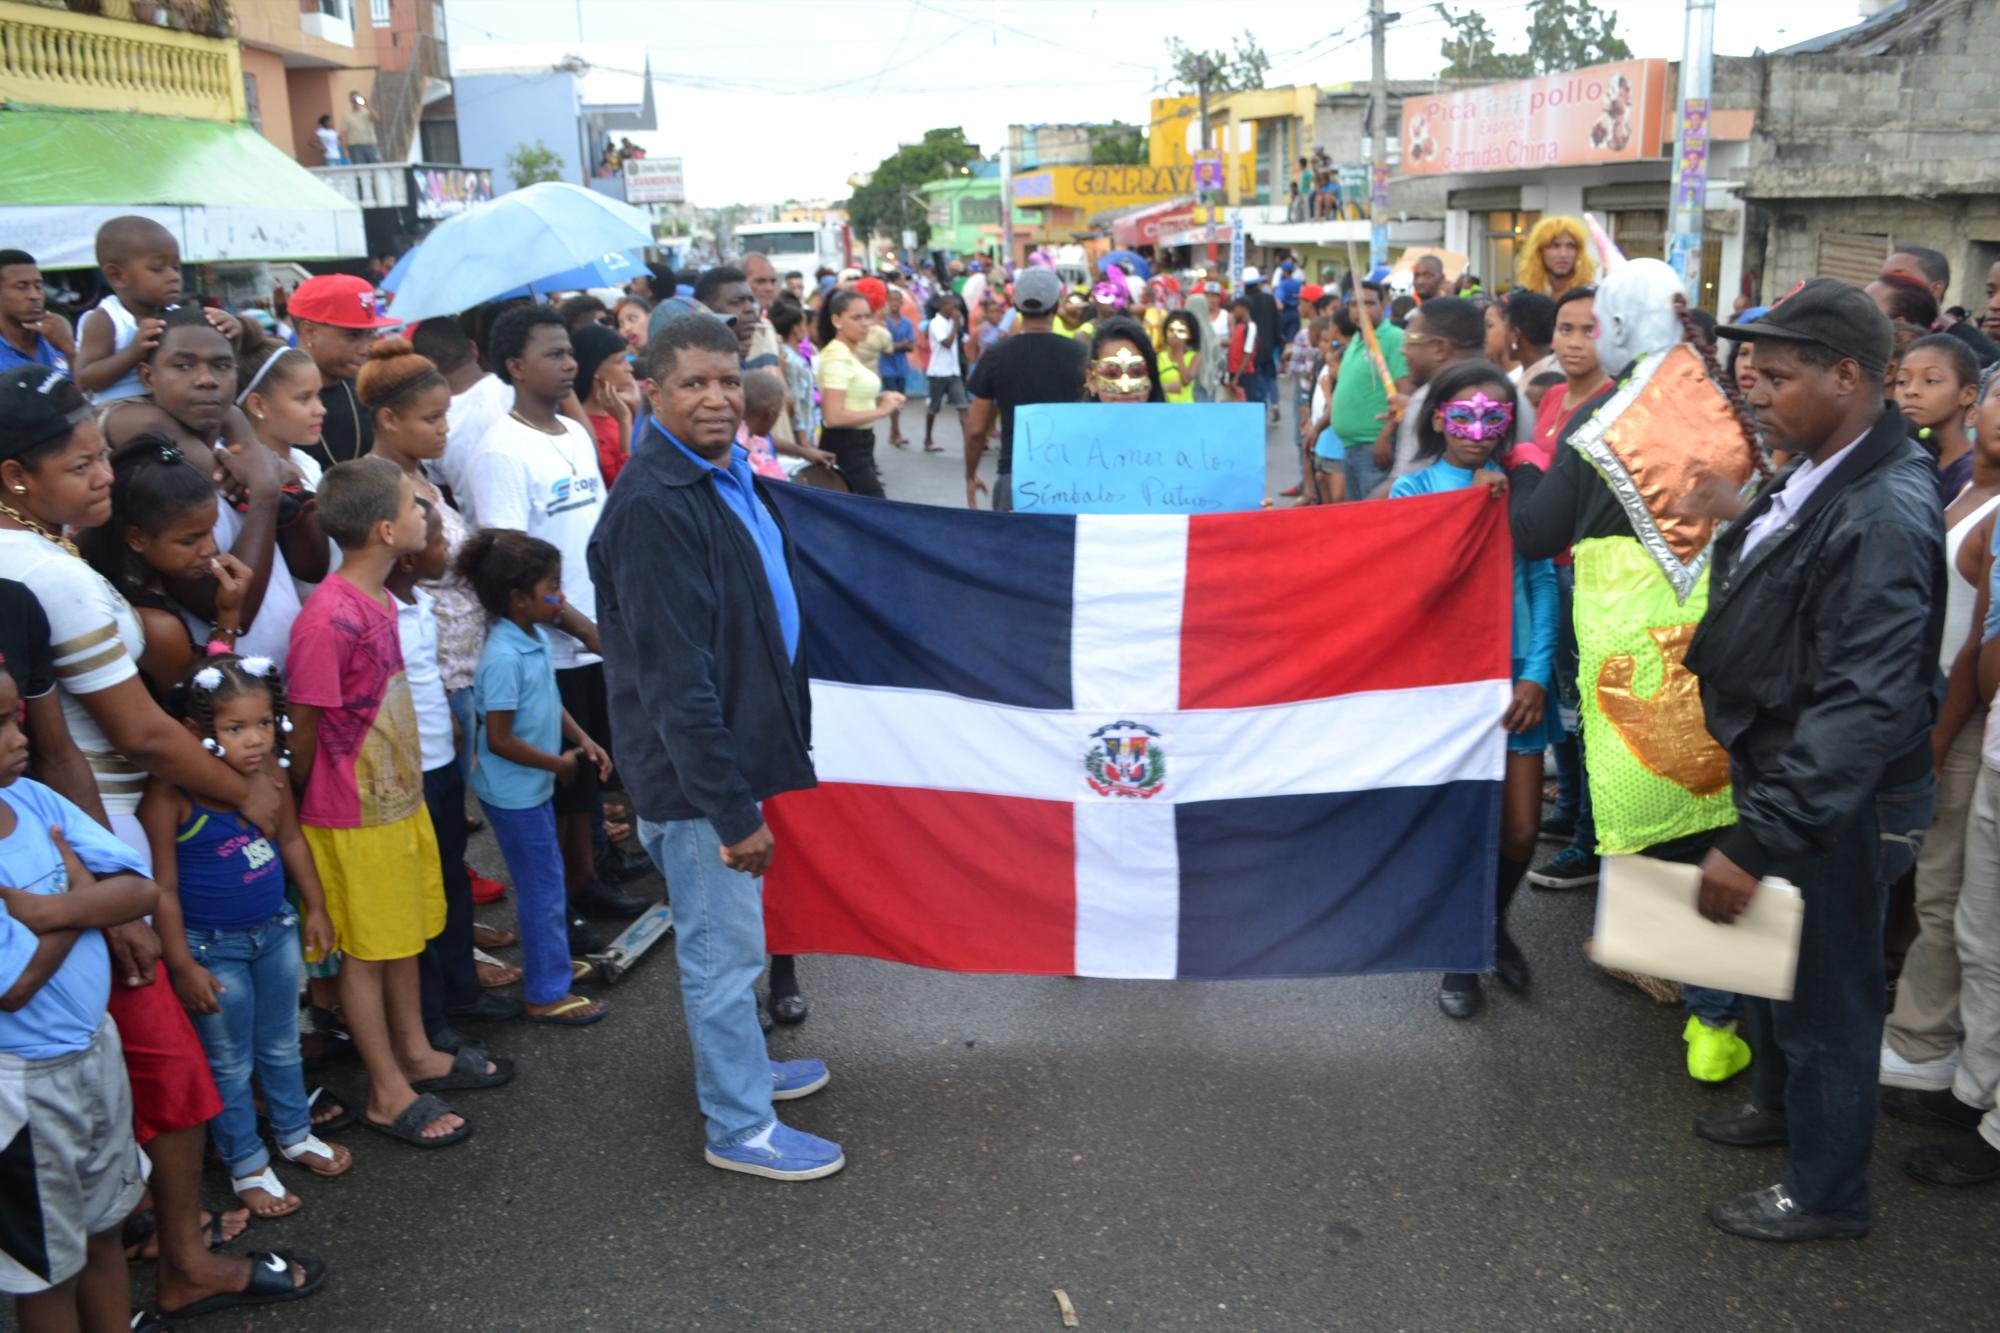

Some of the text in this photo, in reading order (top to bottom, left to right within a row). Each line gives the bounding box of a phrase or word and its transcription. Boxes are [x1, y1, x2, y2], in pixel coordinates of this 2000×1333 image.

[1426, 101, 1477, 122] Pica
[1530, 80, 1602, 115] pollo
[1442, 139, 1559, 170] Comida China
[1088, 438, 1163, 470] Amor
[1175, 450, 1193, 469] a
